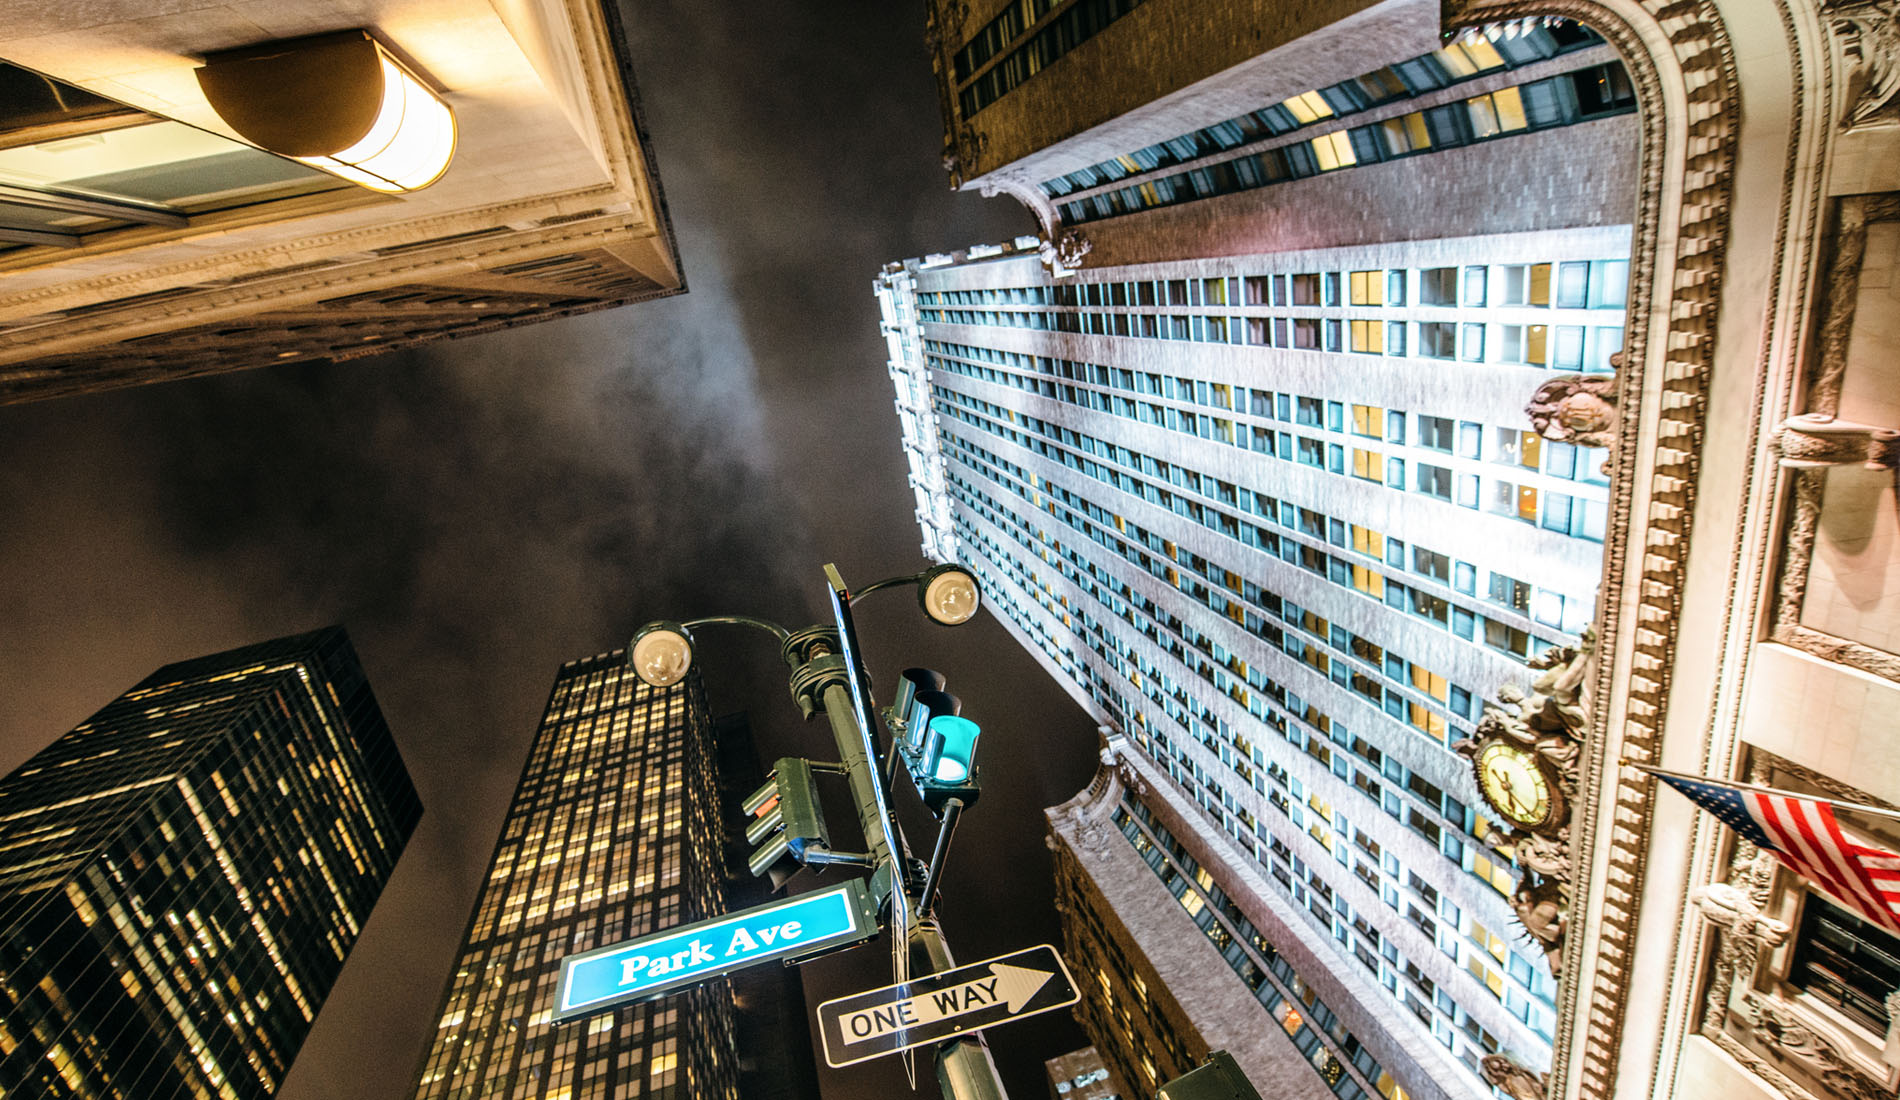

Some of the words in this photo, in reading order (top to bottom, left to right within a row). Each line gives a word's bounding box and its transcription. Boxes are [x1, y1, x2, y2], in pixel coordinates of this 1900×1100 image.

[618, 940, 715, 987] Park
[724, 919, 802, 957] Ave
[850, 1003, 919, 1038] ONE
[933, 979, 998, 1014] WAY
